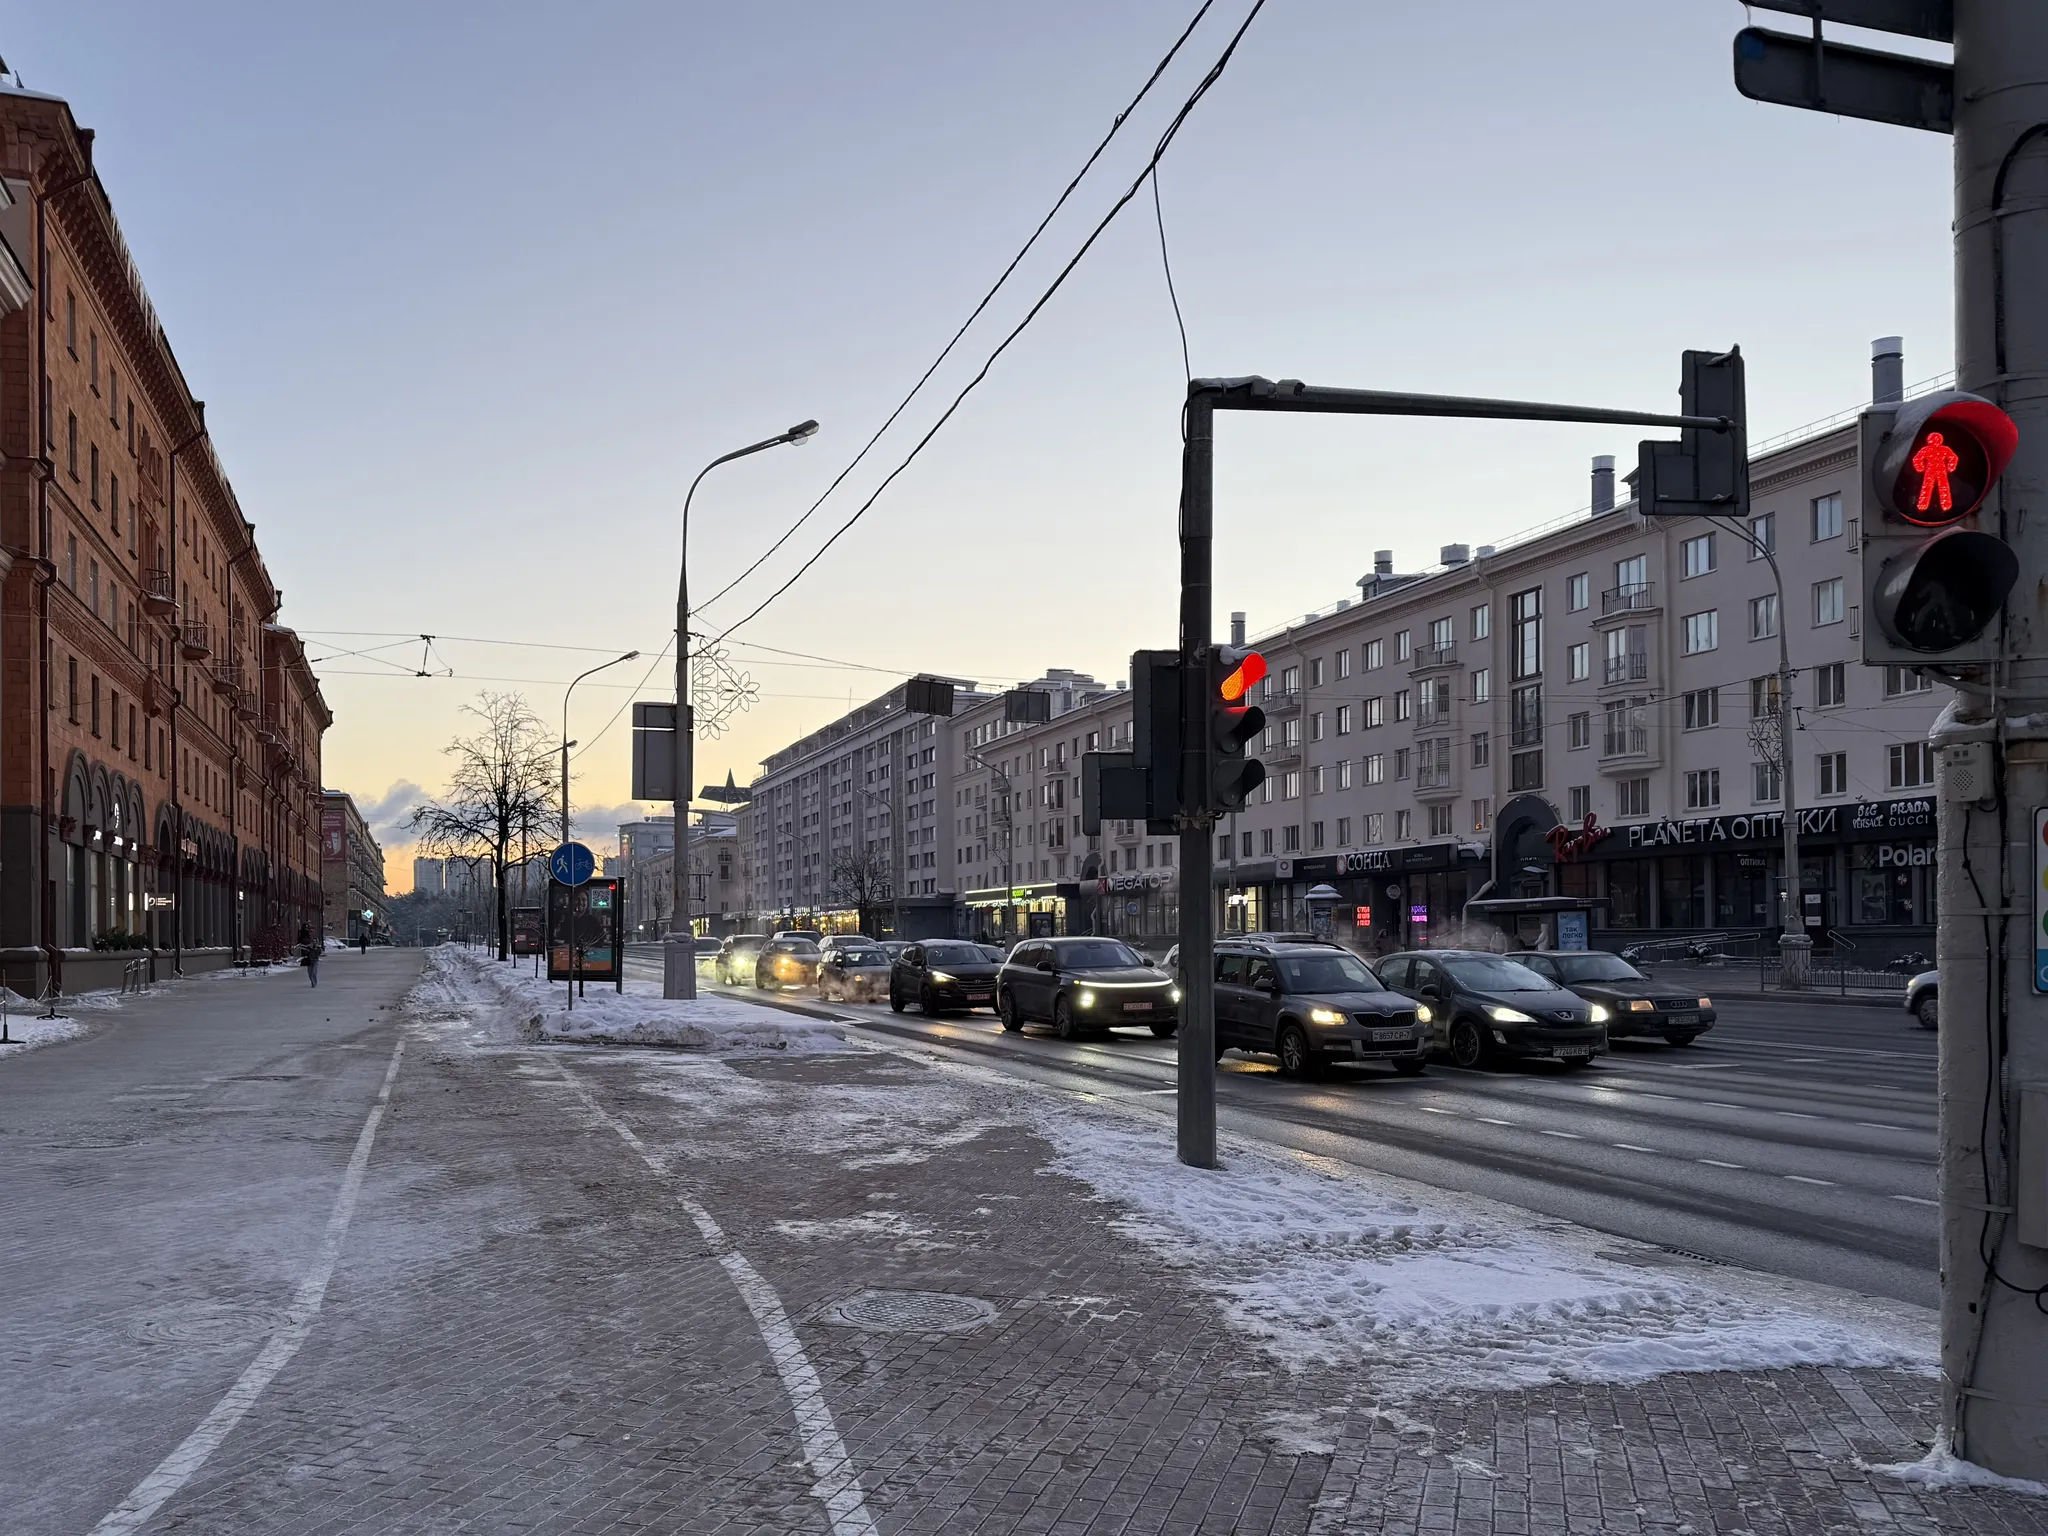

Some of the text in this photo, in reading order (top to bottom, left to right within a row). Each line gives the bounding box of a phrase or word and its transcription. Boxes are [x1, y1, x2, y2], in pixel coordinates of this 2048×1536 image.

[1629, 807, 1838, 847] PLANETA ОПТКИ
[1888, 815, 1929, 826] GUCCI
[1346, 851, 1392, 872] СОНЦА
[1740, 856, 1766, 866] ОПТИКА
[1878, 843, 1938, 868] Polar
[1106, 872, 1173, 891] MEGATOP
